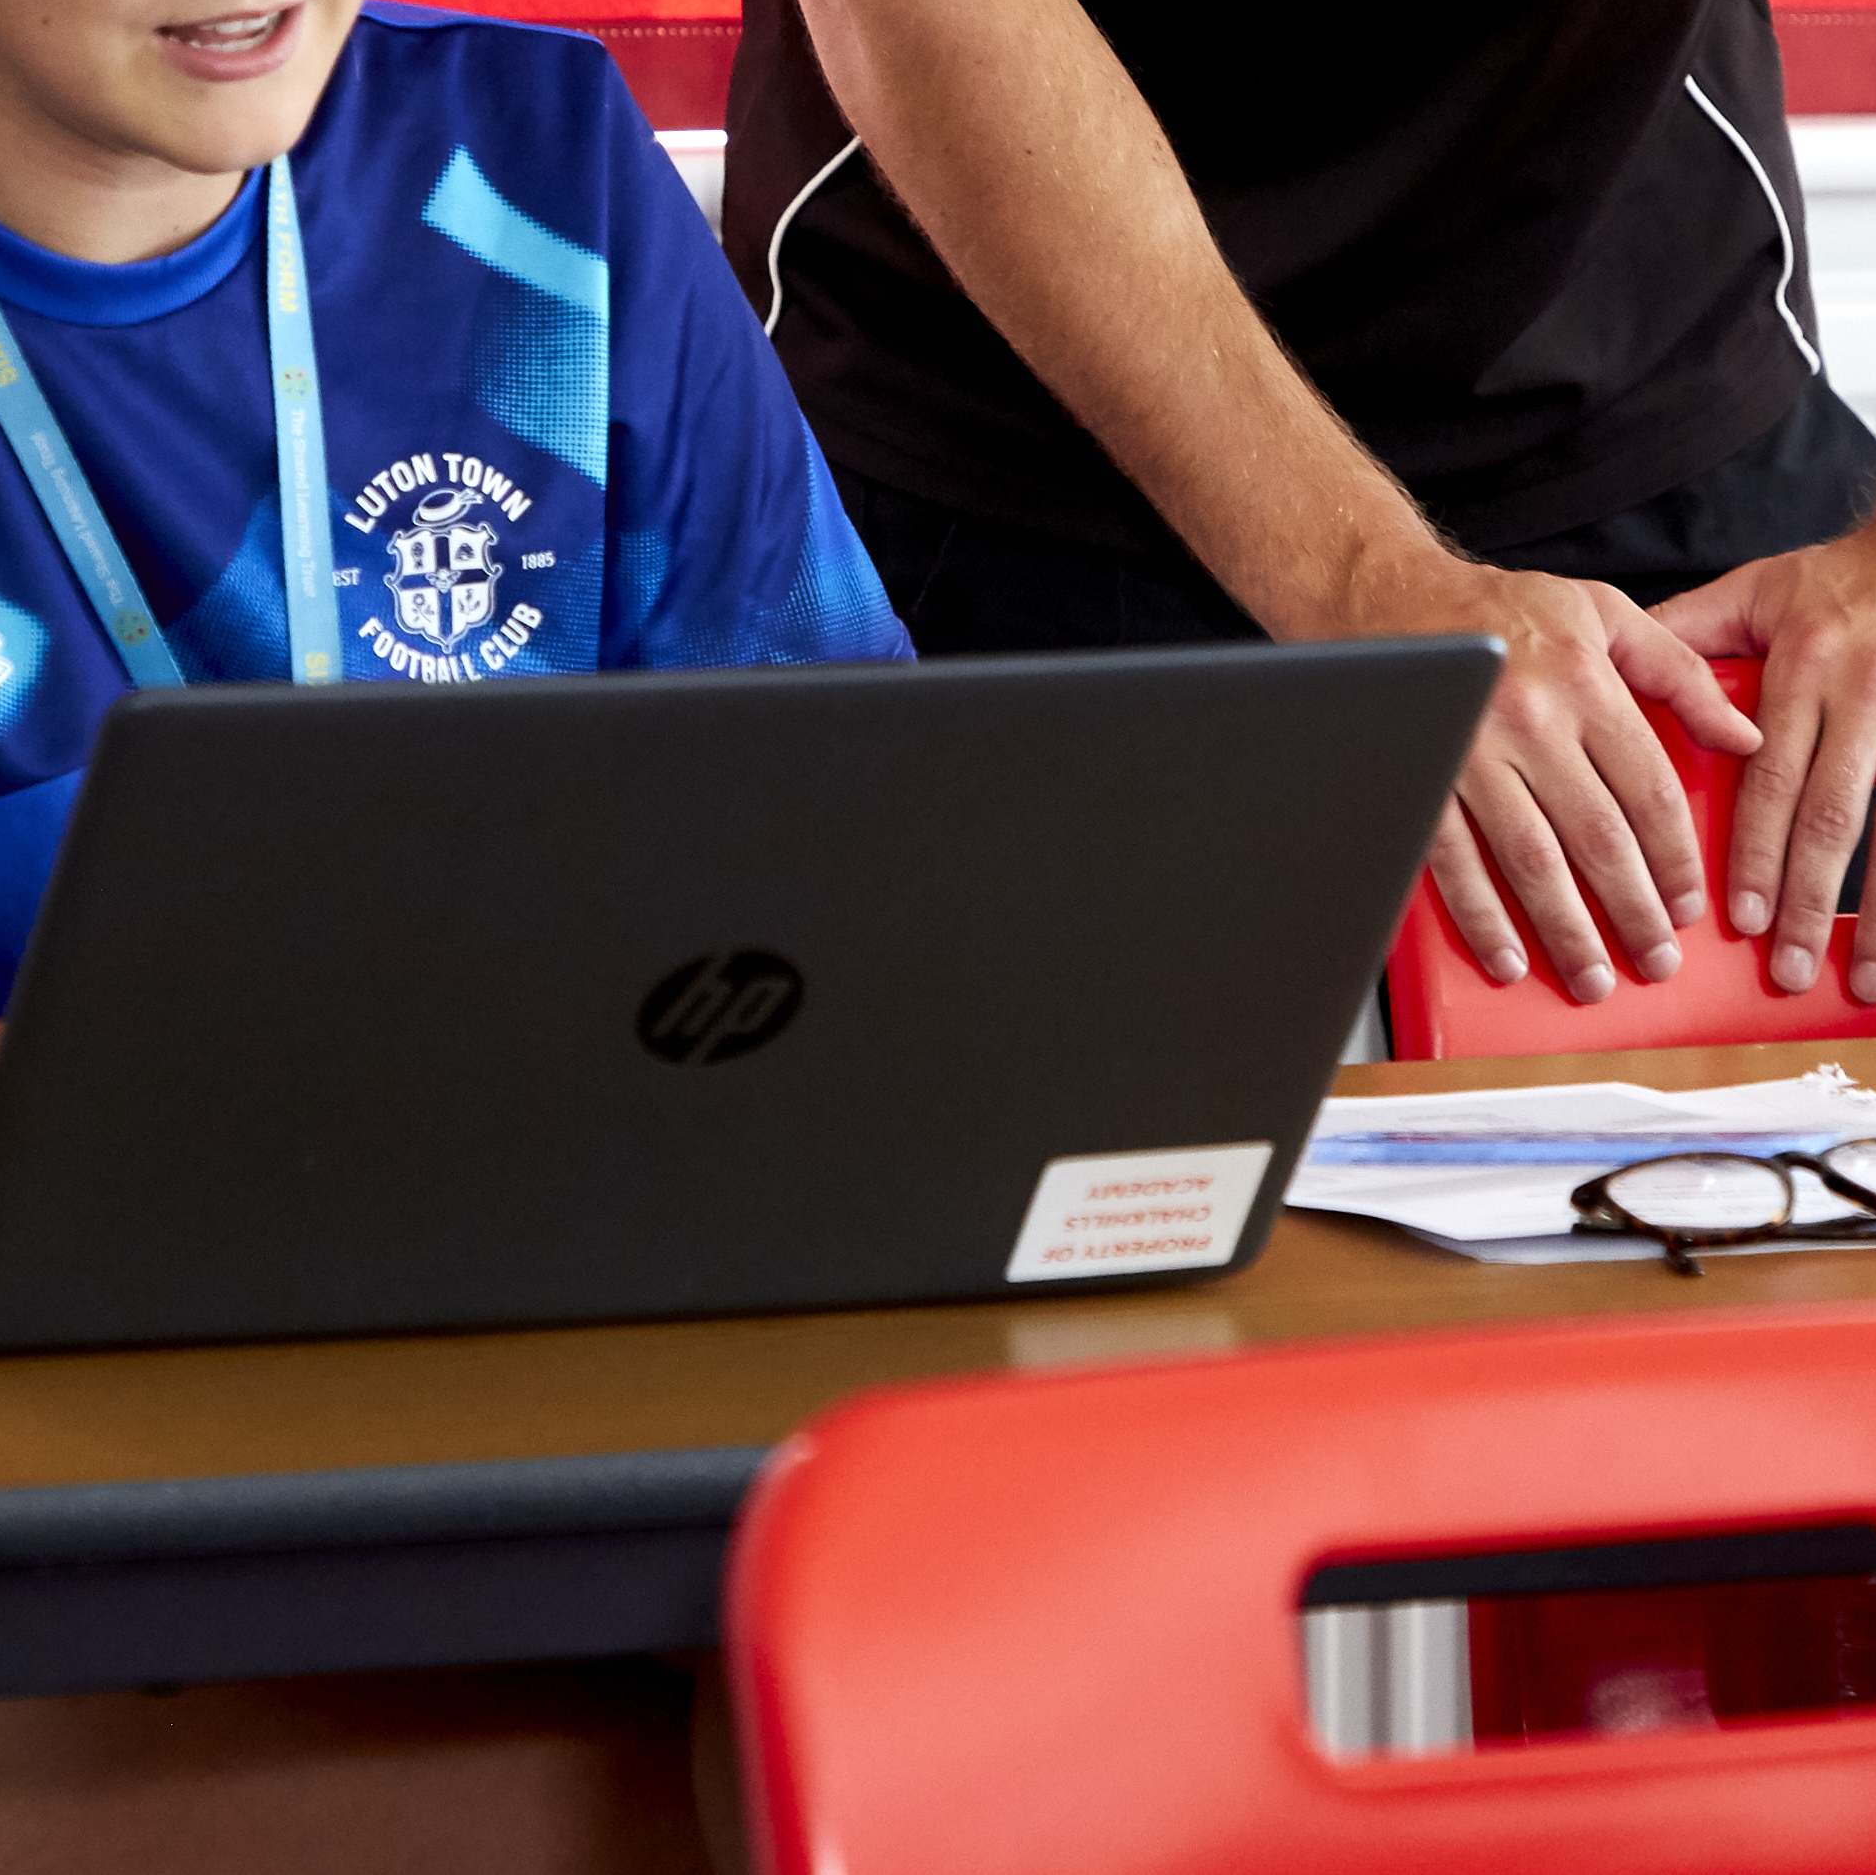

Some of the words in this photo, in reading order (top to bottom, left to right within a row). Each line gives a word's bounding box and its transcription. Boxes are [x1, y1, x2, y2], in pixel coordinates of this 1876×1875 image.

[276, 232, 298, 313] FORM
[344, 452, 439, 535] LUTON
[442, 452, 533, 523] TOWN
[332, 568, 361, 587] EST
[520, 551, 556, 571] 1885
[358, 615, 482, 684] FOOTBALL
[479, 602, 544, 671] CLUB
[1084, 1176, 1215, 1201] ACADEMY
[1039, 1245, 1075, 1264] OF
[1082, 1235, 1214, 1261] PROPERTY
